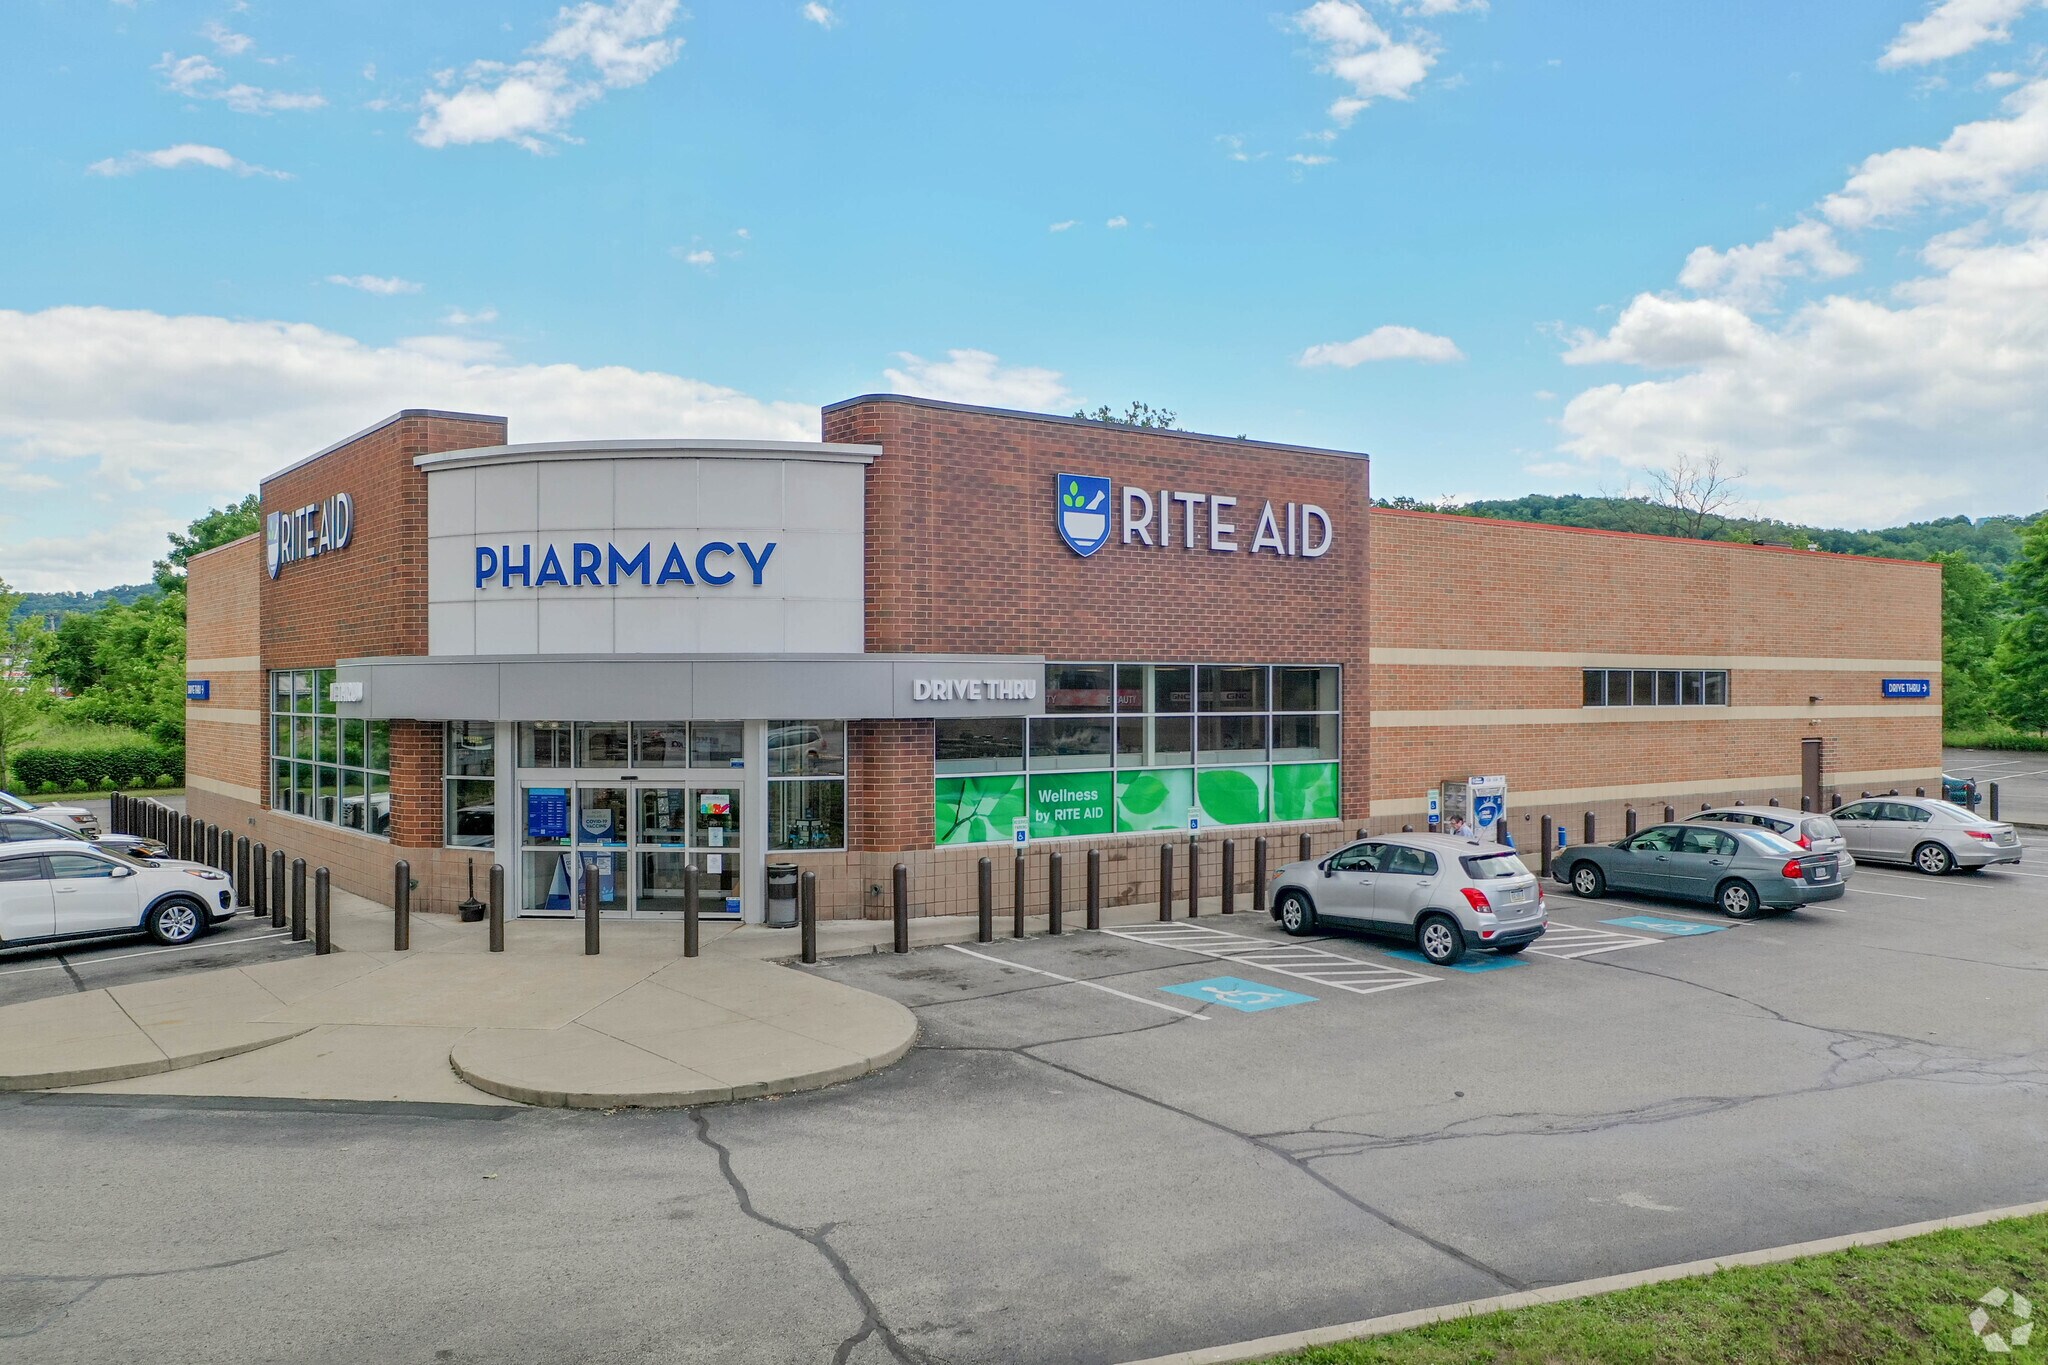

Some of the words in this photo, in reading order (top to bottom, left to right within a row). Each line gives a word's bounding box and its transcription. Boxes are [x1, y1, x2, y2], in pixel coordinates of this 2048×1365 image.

[281, 503, 319, 564] RITE
[319, 492, 354, 553] AID
[1121, 486, 1238, 551] RITE
[1250, 500, 1333, 557] AID
[475, 541, 777, 590] PHARMACY
[913, 679, 982, 701] DRIVE
[983, 679, 1037, 700] THRU
[1226, 692, 1247, 700] GNC
[1888, 683, 1905, 693] DRIVE
[1906, 683, 1921, 693] THRU
[1038, 788, 1099, 803] Wellness
[1035, 809, 1050, 824] by
[1054, 808, 1081, 821] RITE
[1083, 806, 1104, 819] AID
